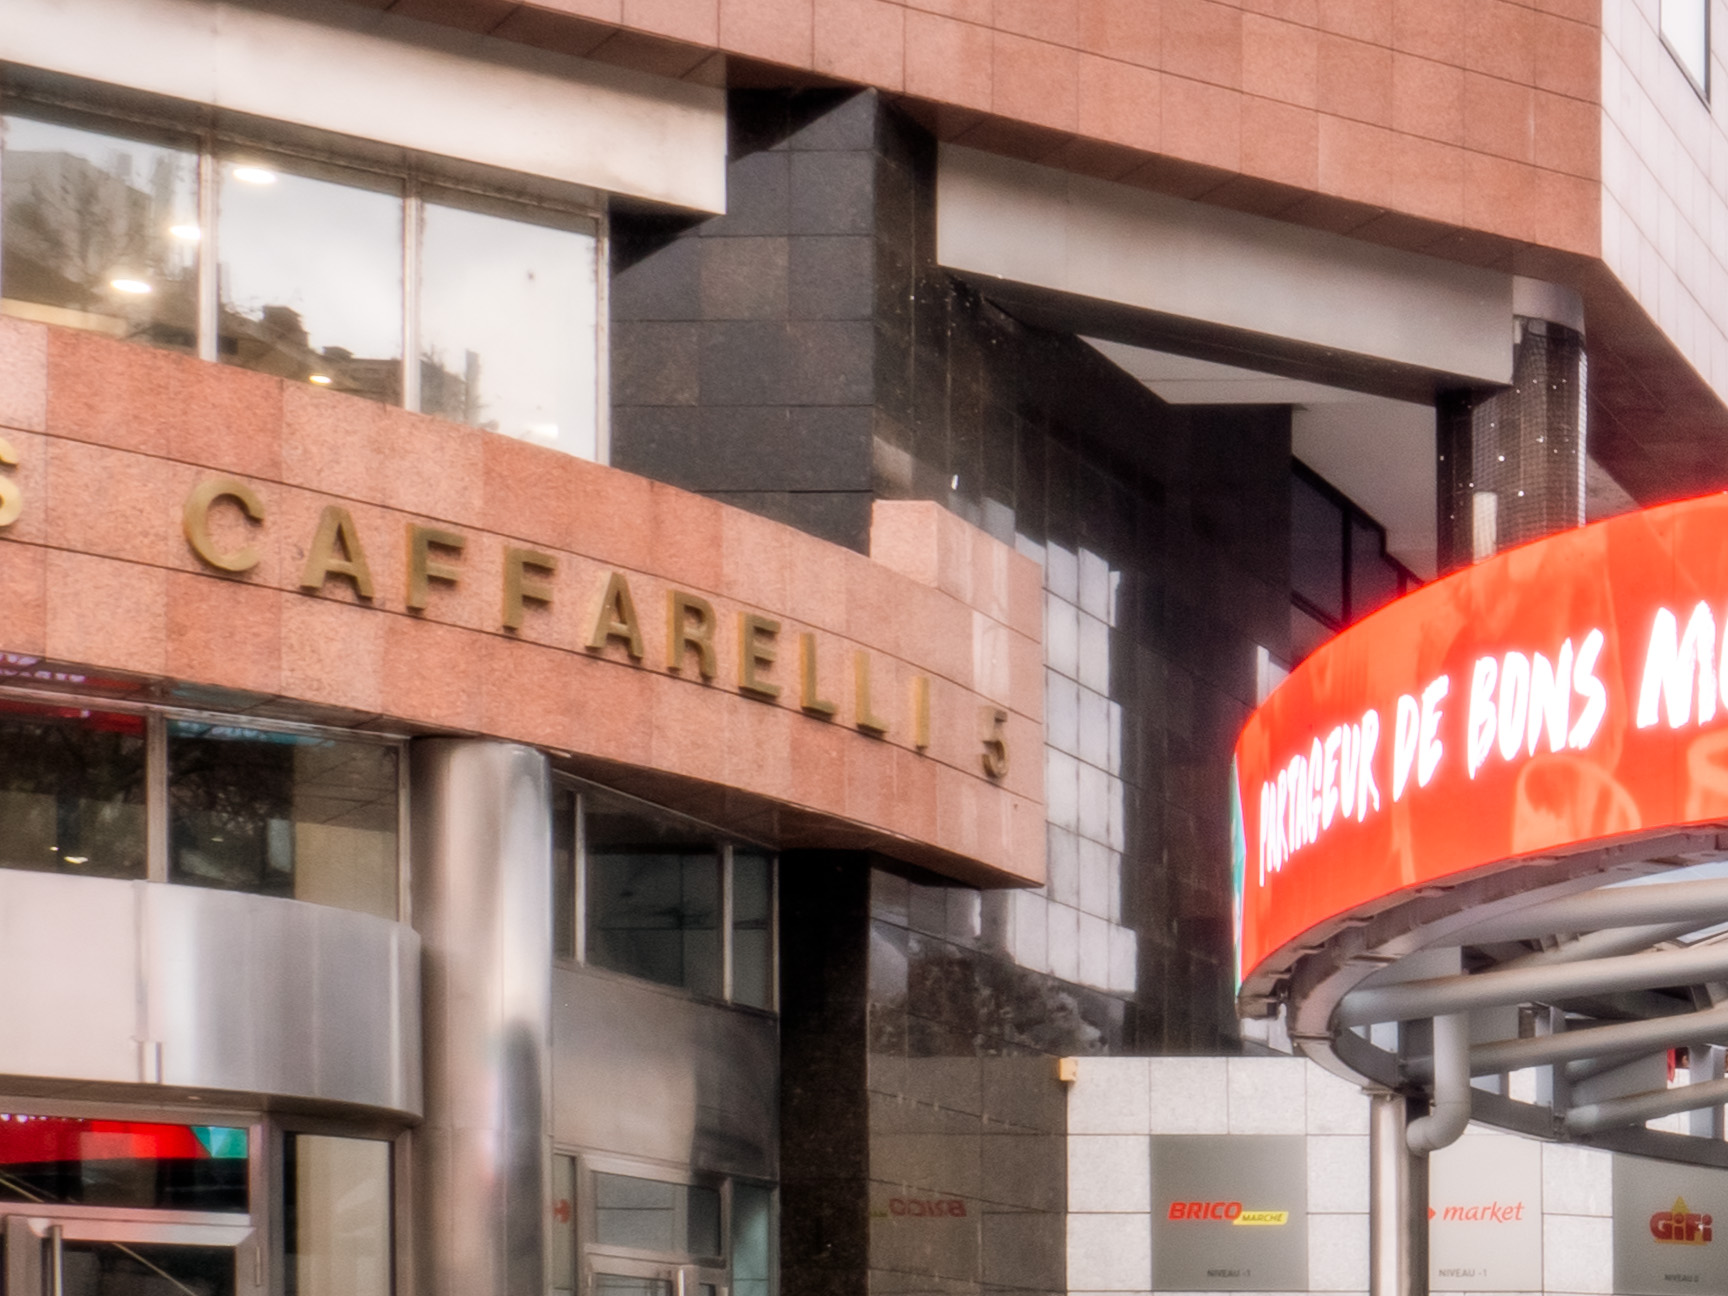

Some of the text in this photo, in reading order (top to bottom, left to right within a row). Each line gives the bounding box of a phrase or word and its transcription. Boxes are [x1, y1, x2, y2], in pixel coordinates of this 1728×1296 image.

[184, 478, 932, 752] CAFFARELLI
[1258, 708, 1382, 886] PARTAGEUR
[1392, 674, 1450, 802] DE
[1467, 628, 1606, 780] BONS
[1168, 1201, 1243, 1221] BRICO
[1443, 1201, 1525, 1224] market
[1207, 1269, 1241, 1278] NIVEAU
[1439, 1269, 1476, 1277] NIVEAU
